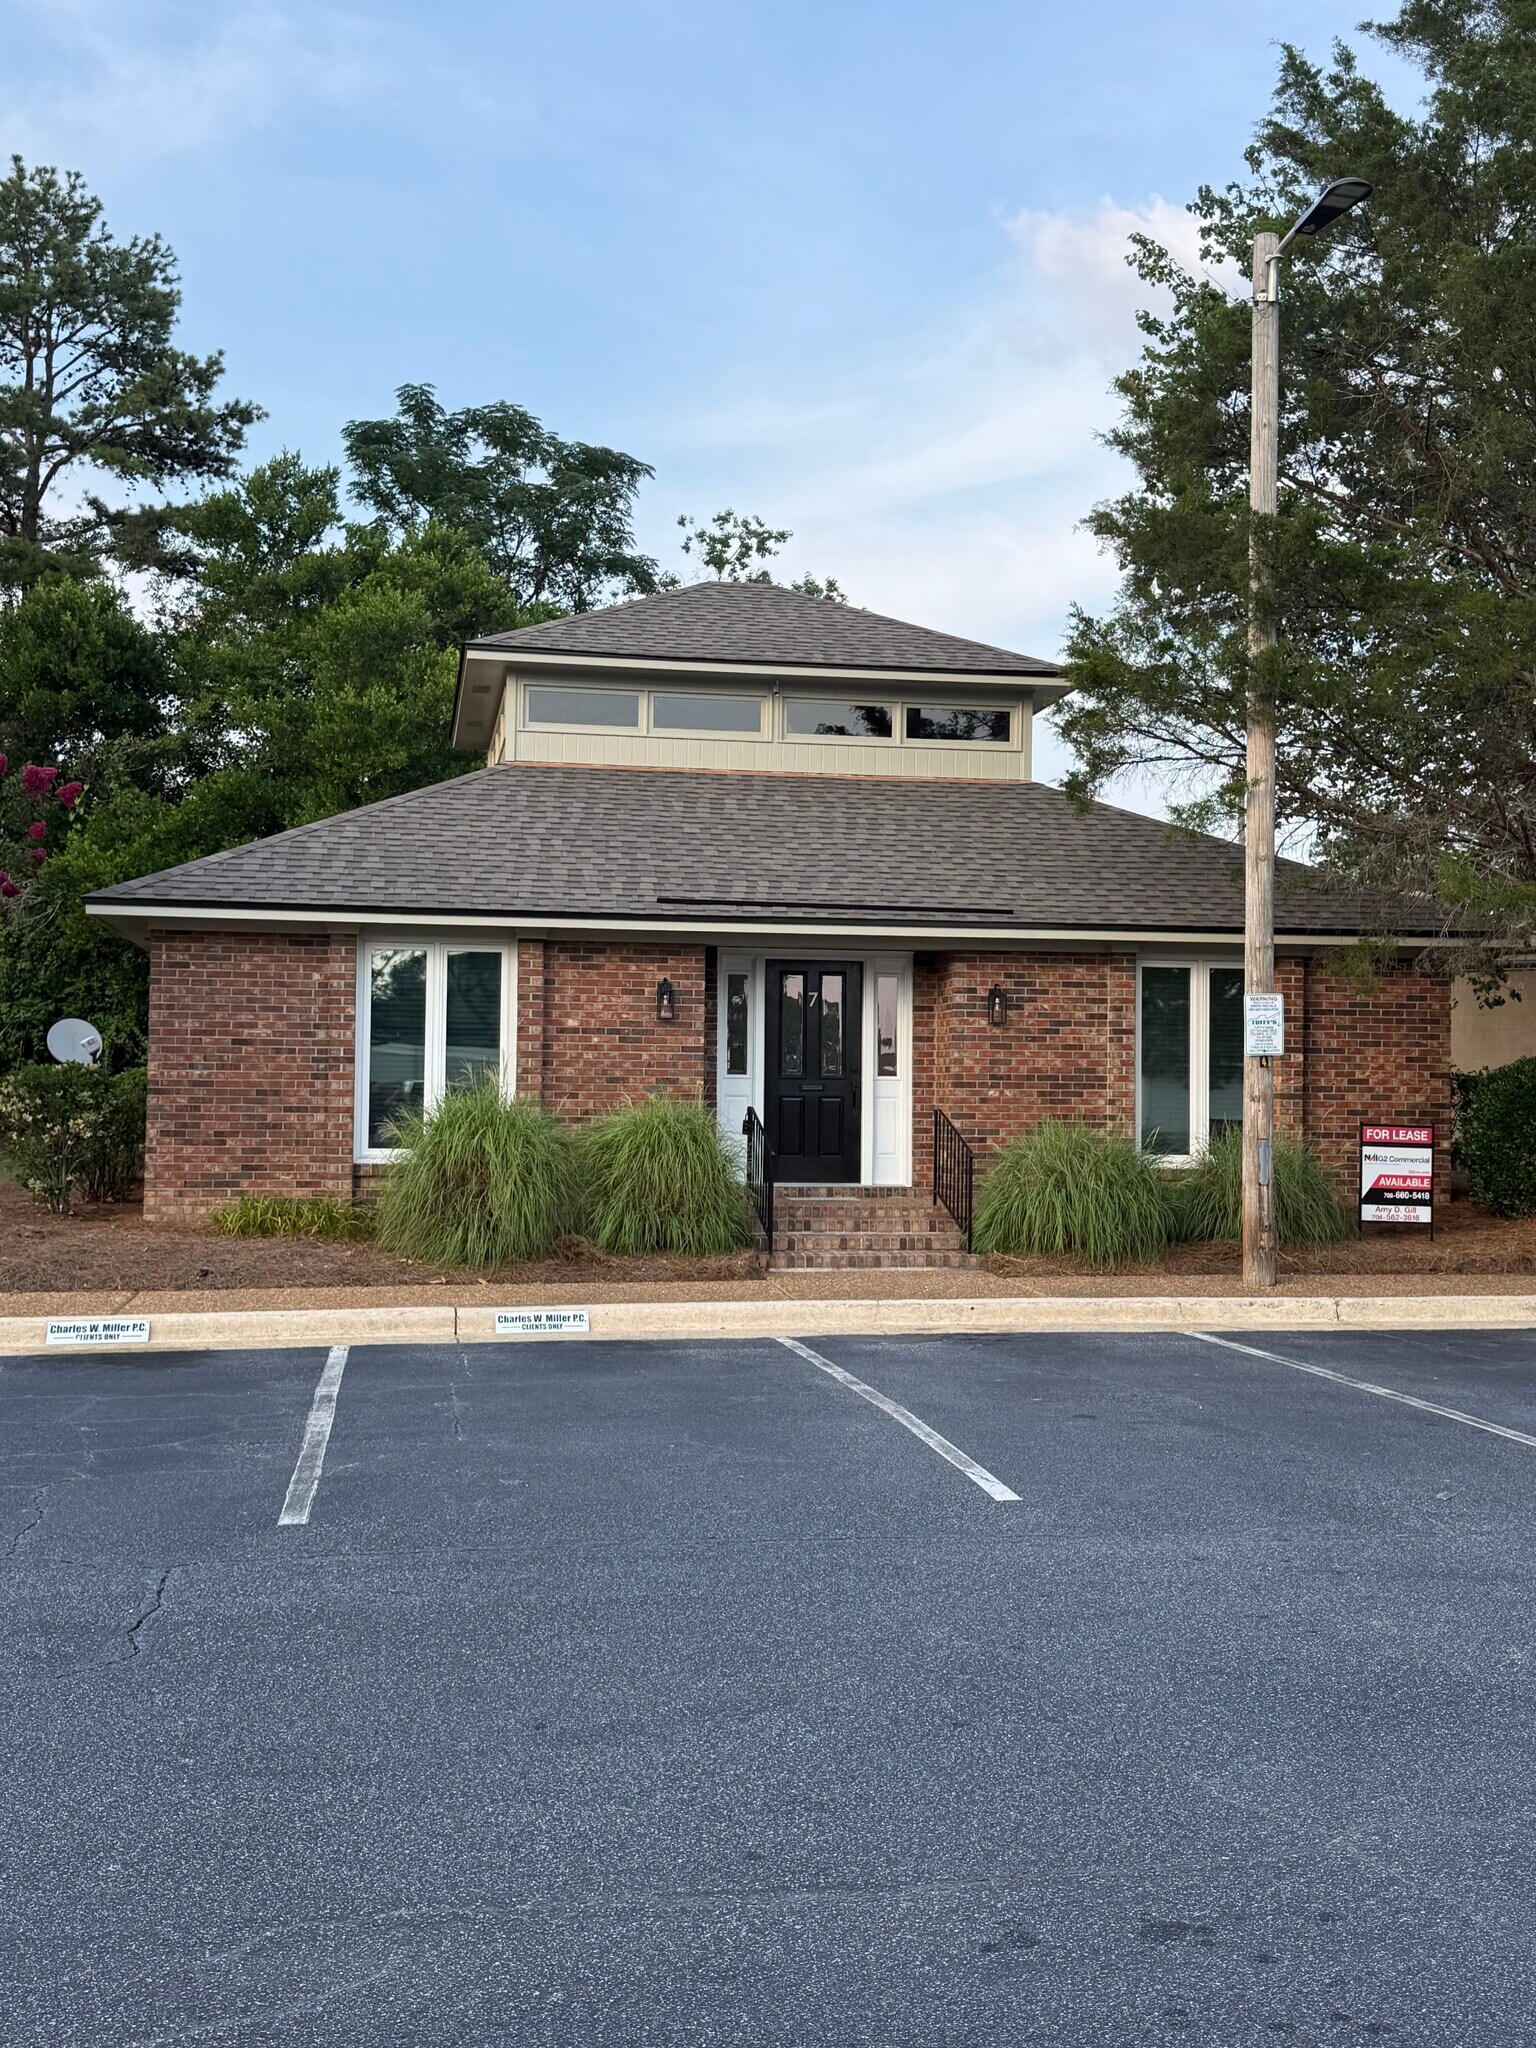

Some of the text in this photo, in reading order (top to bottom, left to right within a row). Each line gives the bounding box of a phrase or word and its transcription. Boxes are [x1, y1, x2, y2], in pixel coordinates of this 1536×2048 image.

[808, 991, 819, 1008] 7
[1366, 1129, 1429, 1141] FOR LEASE
[1389, 1155, 1430, 1164] Commercial
[1379, 1176, 1431, 1187] AVAILABLE
[1383, 1191, 1430, 1200] 706-660-5418
[1375, 1206, 1417, 1215] Amy D. Gill
[497, 1314, 532, 1324] Charles
[545, 1313, 572, 1323] Miller
[572, 1313, 587, 1323] P.C.
[50, 1324, 88, 1334] Charles
[102, 1323, 131, 1333] Miller
[132, 1322, 147, 1332] P.C.
